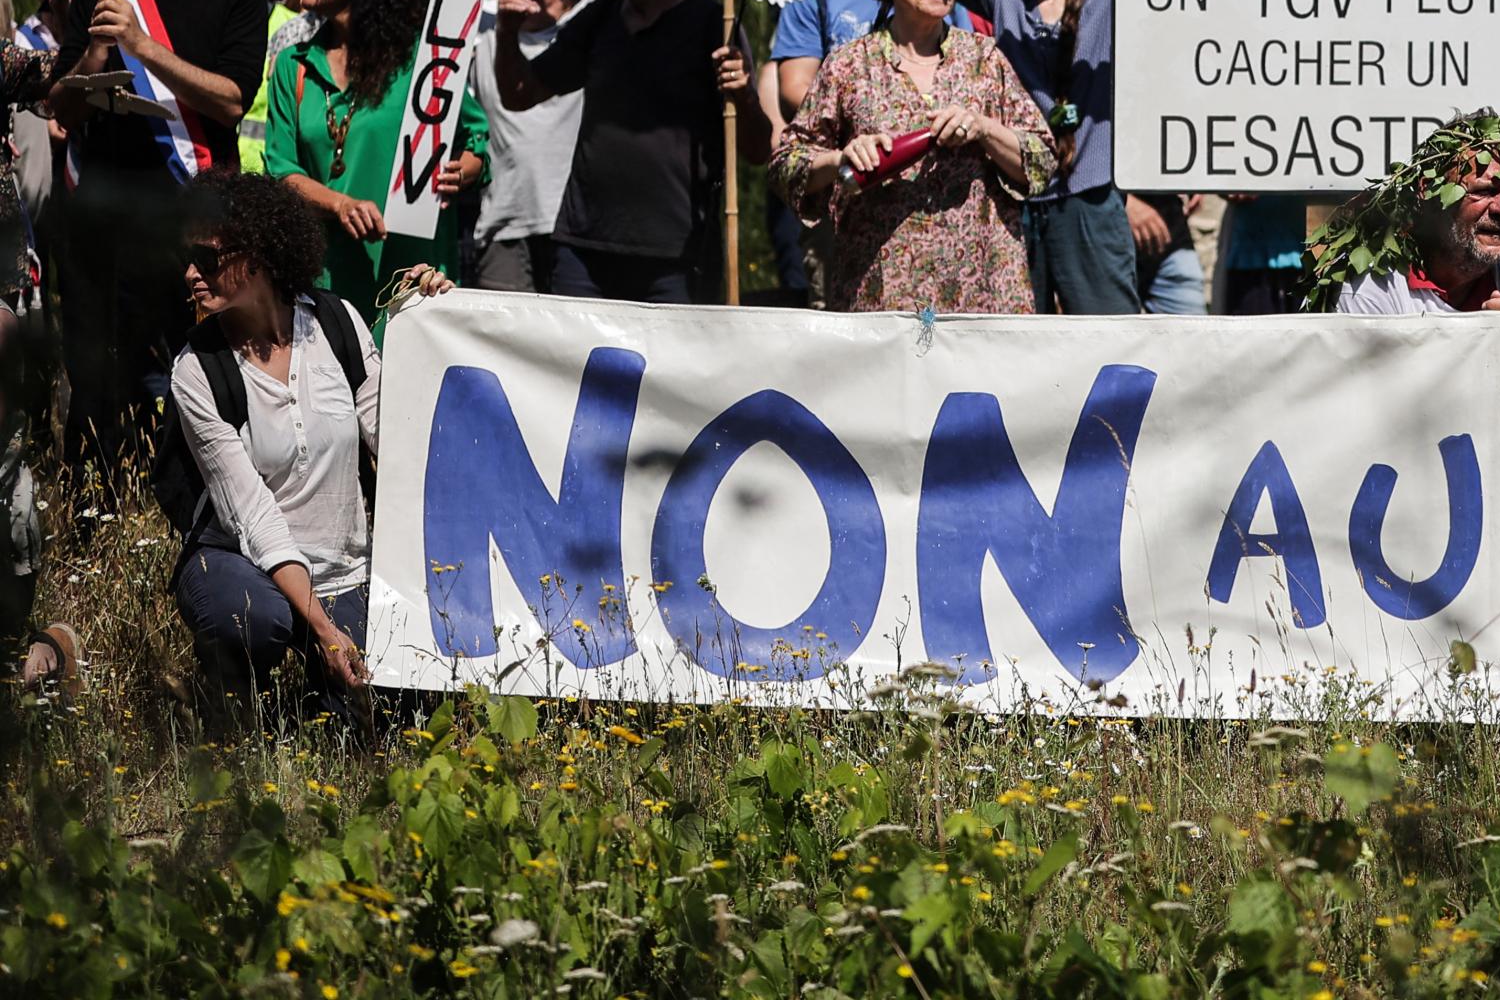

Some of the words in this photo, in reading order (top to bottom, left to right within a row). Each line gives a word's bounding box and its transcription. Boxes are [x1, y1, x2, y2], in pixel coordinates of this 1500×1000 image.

[1194, 39, 1386, 86] CACHER
[1407, 41, 1469, 87] UN
[1160, 115, 1443, 176] DESAST
[424, 346, 1157, 687] NON
